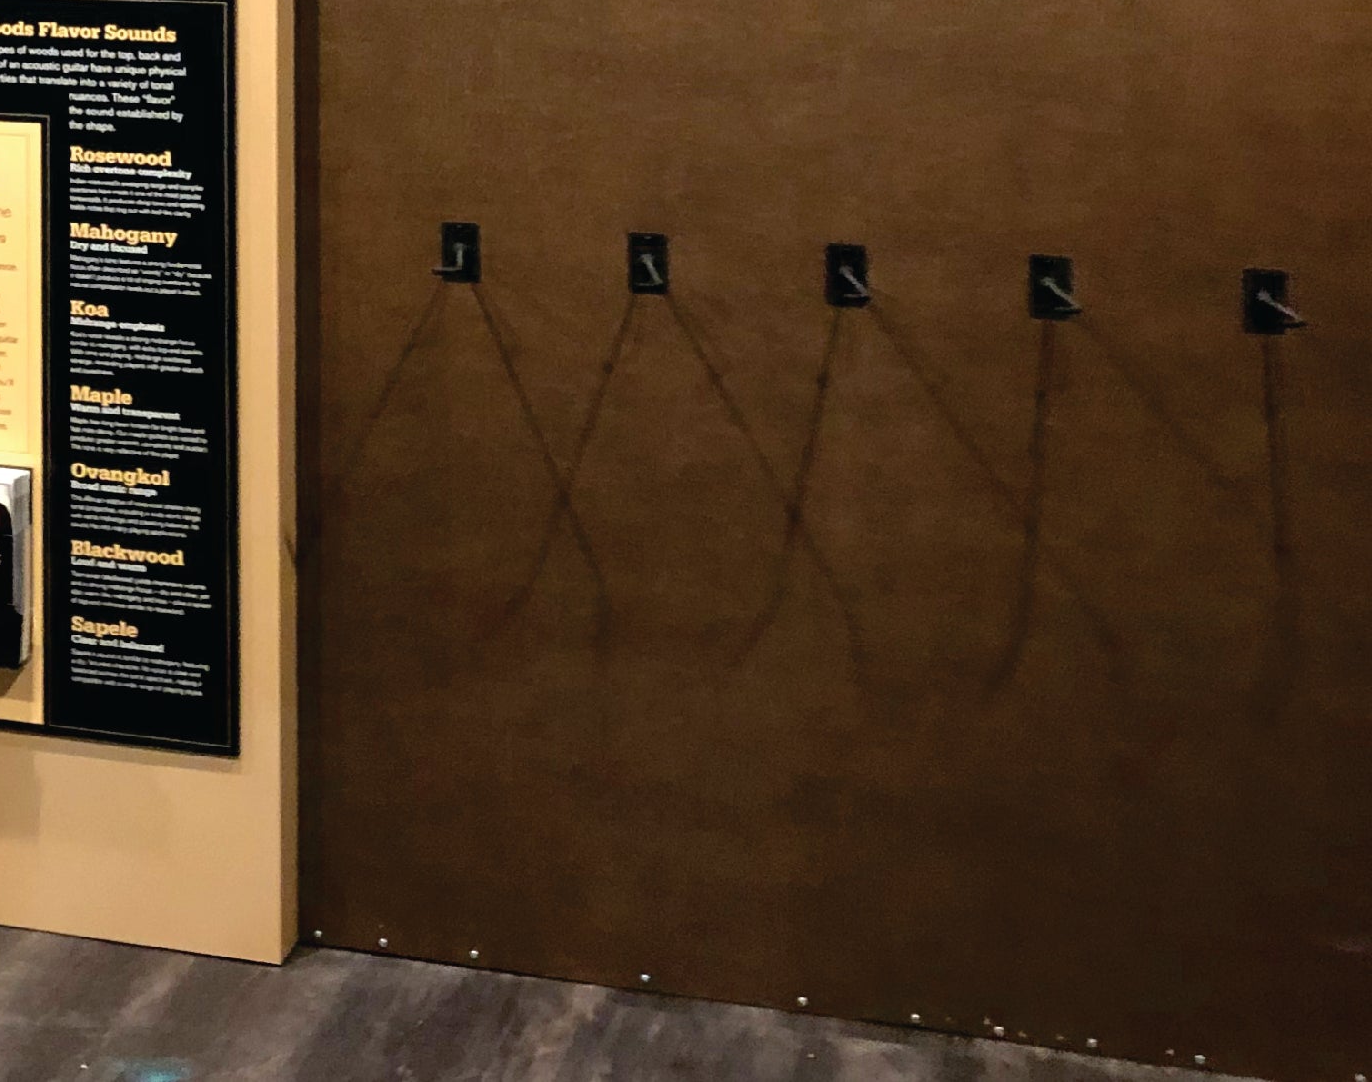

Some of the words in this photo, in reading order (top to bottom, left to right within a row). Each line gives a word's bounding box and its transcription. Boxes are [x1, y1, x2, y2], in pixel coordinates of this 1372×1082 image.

[38, 22, 101, 39] Flavor
[104, 24, 177, 42] Sounds
[70, 146, 172, 166] Rosewood
[70, 223, 178, 247] Mahogany
[70, 300, 109, 317] Koa
[70, 385, 133, 405] Maple
[70, 463, 170, 486] Ovangkol
[70, 540, 185, 565] Blackwood
[70, 616, 139, 638] Sapele
